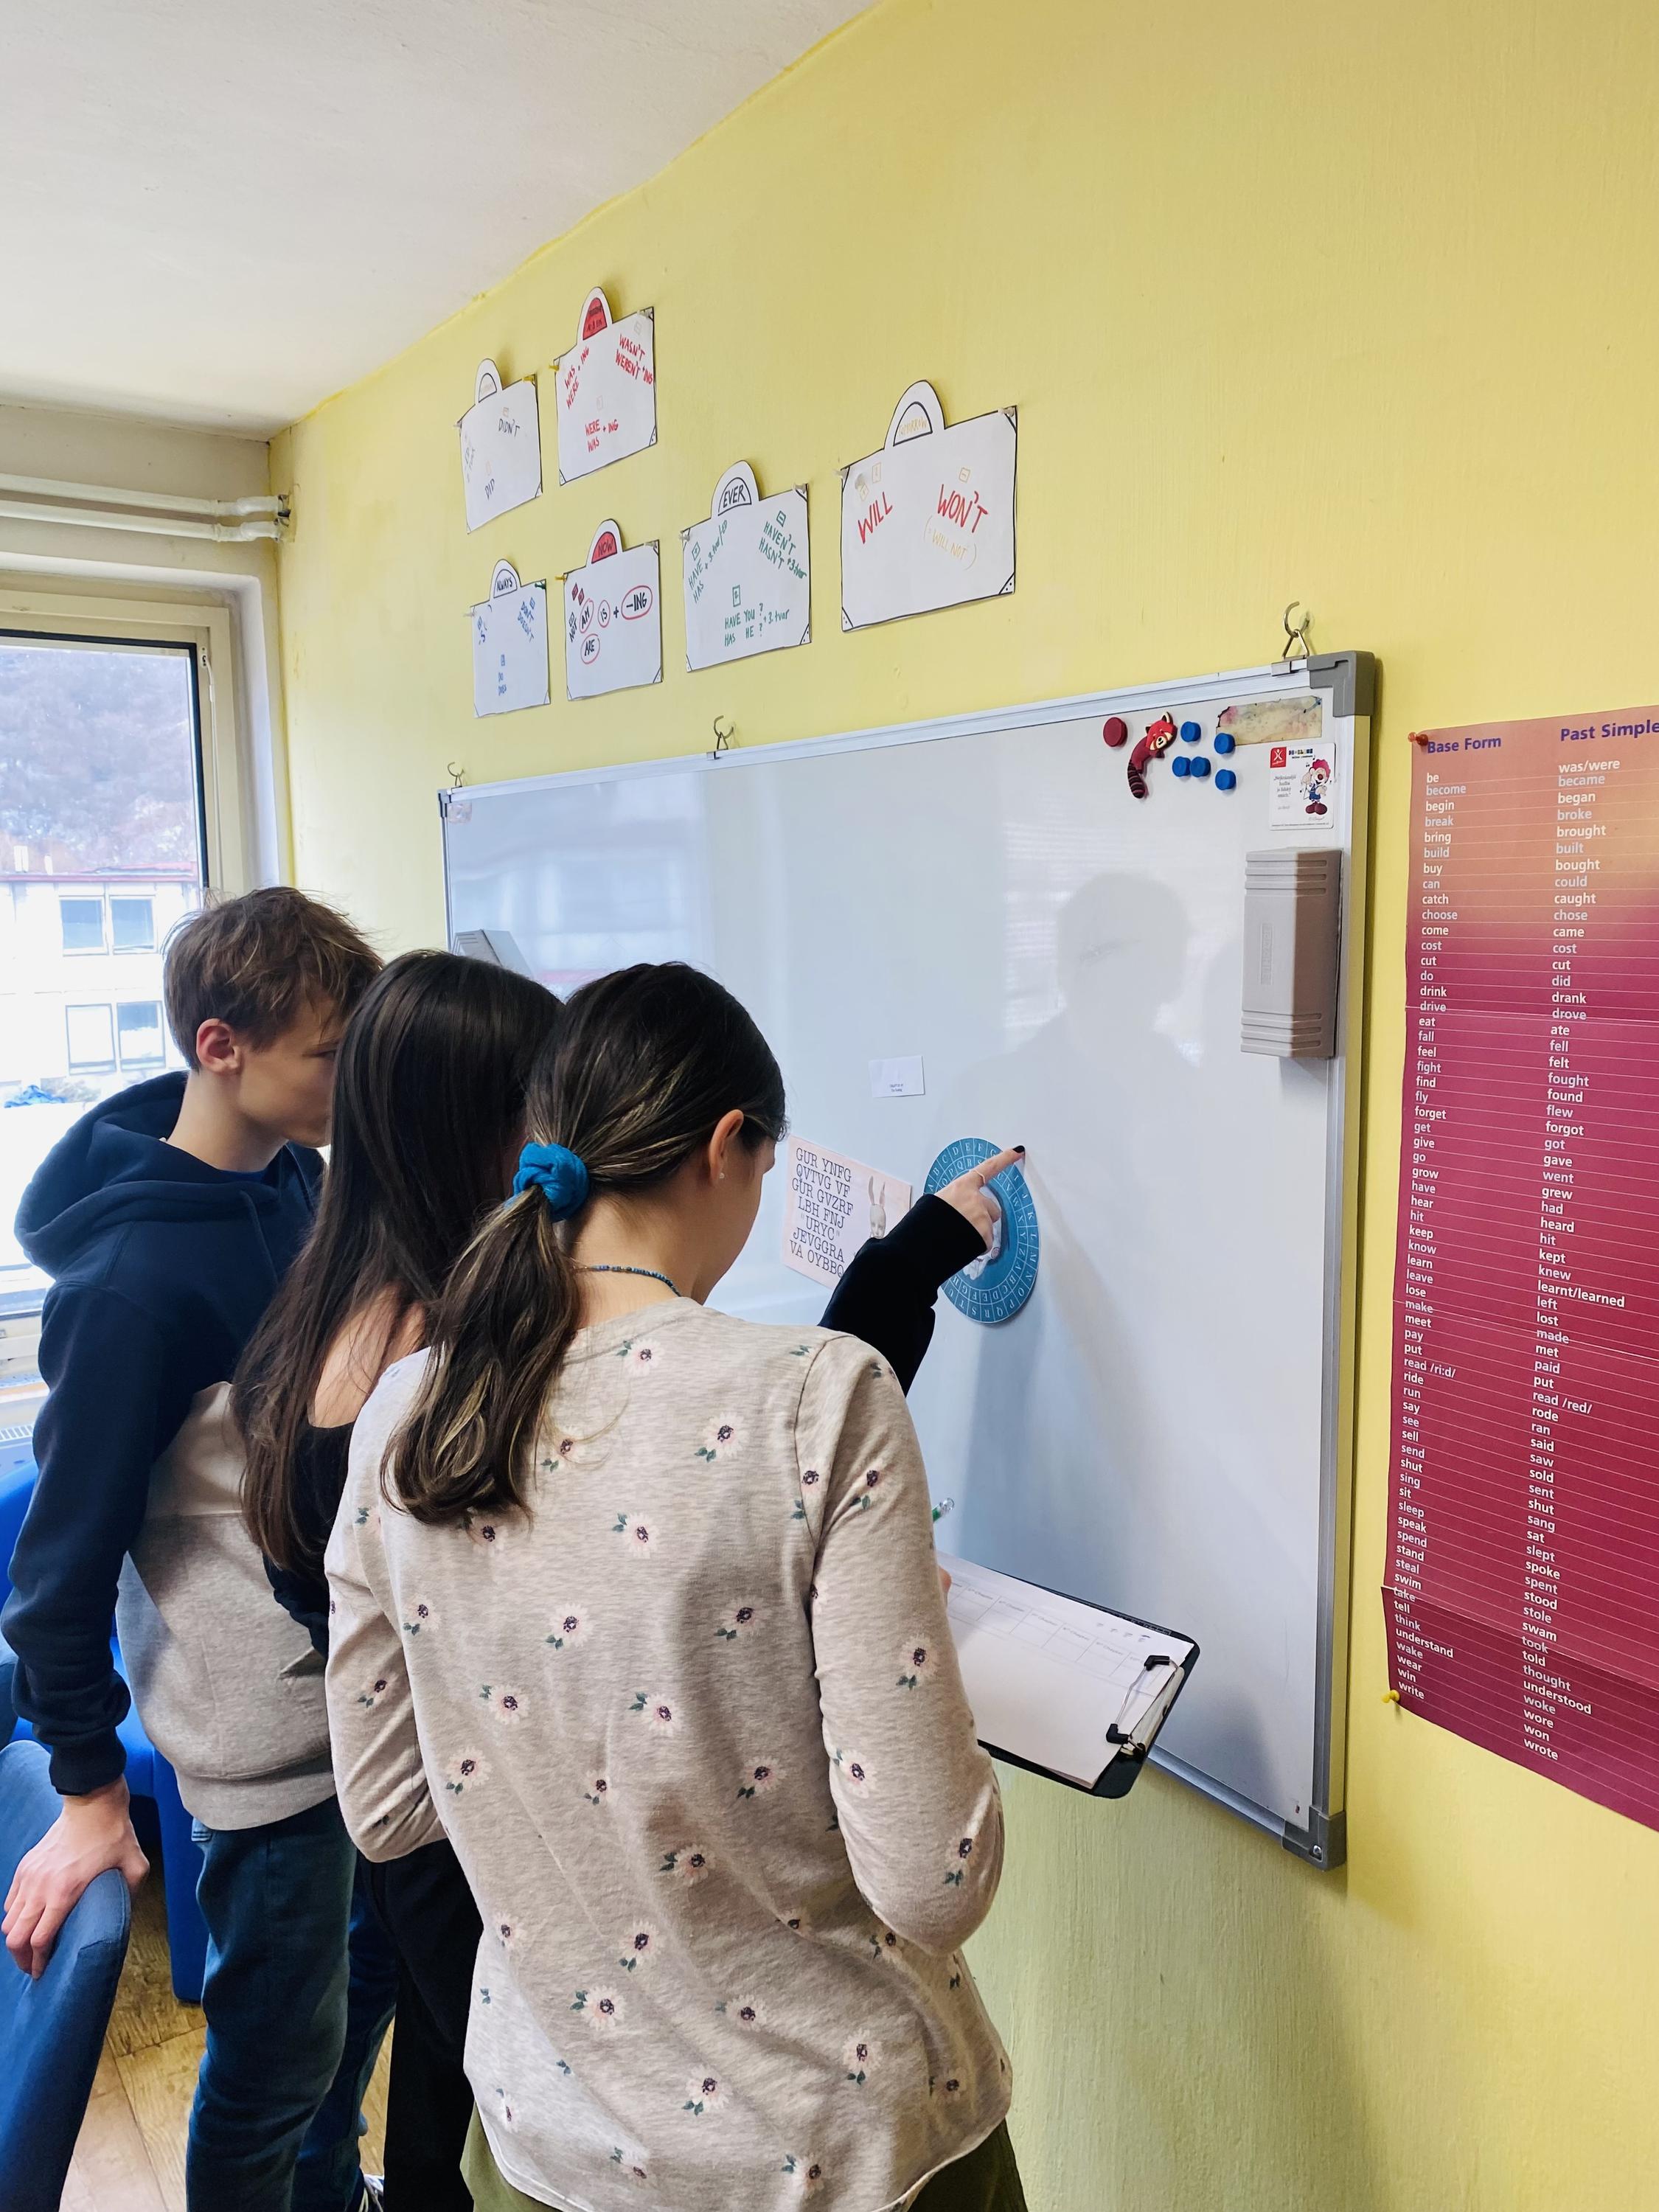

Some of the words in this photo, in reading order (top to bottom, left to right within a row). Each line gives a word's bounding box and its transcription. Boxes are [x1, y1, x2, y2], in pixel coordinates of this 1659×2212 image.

[619, 333, 645, 361] WASN'T
[616, 349, 640, 380] WEREN'T
[498, 418, 520, 437] DIDN'T
[585, 419, 600, 437] WERE
[608, 419, 619, 434] ING
[588, 438, 599, 453] WAS
[484, 478, 495, 500] DID
[723, 484, 745, 508] EVER
[937, 484, 988, 533] WON'T
[858, 491, 893, 544] WILL
[763, 521, 796, 555] HAVEN'T
[598, 540, 613, 556] NOW
[759, 537, 785, 569] HASN'T
[689, 557, 703, 589] HAVE
[497, 577, 513, 591] ALWAYS
[693, 580, 704, 603] HAS
[569, 618, 577, 643] NOT
[582, 606, 590, 629] AM
[601, 608, 608, 622] IS
[725, 613, 741, 630] HAVE
[744, 609, 755, 622] YOU
[725, 633, 736, 647] HAS
[745, 625, 754, 639] HE
[584, 639, 595, 656] ARE
[1561, 728, 1596, 741] Past
[1601, 720, 1659, 738] Simple
[1427, 742, 1459, 754] Base
[1464, 737, 1502, 751] Form
[1559, 759, 1620, 773] was/were
[1427, 773, 1439, 783] be
[1426, 799, 1455, 812] begin
[1558, 792, 1596, 805] began
[1425, 832, 1451, 844] bring
[1557, 825, 1606, 839] brought
[1424, 863, 1442, 876] buy
[1555, 860, 1600, 872] bought
[1422, 894, 1448, 905] catch
[1554, 894, 1596, 906] caught
[1422, 926, 1449, 936] come
[1554, 927, 1585, 937] came
[1422, 941, 1441, 951] cost
[1553, 944, 1576, 953] cost
[1421, 956, 1436, 967] cut
[1552, 960, 1571, 970] cut
[1420, 971, 1433, 981] do
[1552, 975, 1571, 987] did
[1420, 986, 1447, 997] drink
[1552, 992, 1587, 1004] drank
[1419, 1018, 1436, 1027] eat
[1419, 1032, 1434, 1042] fall
[1551, 1026, 1570, 1035] ate
[1417, 1047, 1436, 1057] feel
[1550, 1041, 1568, 1052] fell
[1549, 1057, 1569, 1068] felt
[1416, 1077, 1436, 1088] find
[1548, 1090, 1583, 1102] found
[1415, 1107, 1446, 1120] forget
[1545, 1122, 1584, 1135] forgot
[1413, 1137, 1434, 1150] give
[796, 1147, 818, 1168] GUR
[822, 1158, 852, 1183] YNFG
[1543, 1156, 1572, 1168] gave
[796, 1164, 831, 1190] QVTVG
[835, 1179, 850, 1198] VF
[1413, 1168, 1439, 1180] grow
[792, 1178, 813, 1199] GUR
[817, 1189, 854, 1216] GVZRF
[1542, 1188, 1573, 1200] grew
[1411, 1196, 1433, 1208] hear
[798, 1196, 820, 1218] LBH
[824, 1208, 845, 1229] FNJ
[801, 1213, 840, 1241] "URYC"
[1541, 1217, 1574, 1232] heard
[1409, 1225, 1433, 1239] keep
[793, 1227, 845, 1262] JEVGGRA
[1408, 1240, 1436, 1254] know
[789, 1239, 804, 1259] VA
[807, 1249, 844, 1279] OYBBQ
[1408, 1255, 1433, 1269] learn
[1540, 1249, 1565, 1264] kept
[1407, 1270, 1433, 1284] leave
[1539, 1265, 1571, 1280] knew
[1405, 1284, 1426, 1297] lose
[1538, 1281, 1625, 1307] learnt/learned
[1537, 1297, 1557, 1310] left
[1405, 1315, 1432, 1327] meet
[1537, 1312, 1558, 1326] lost
[1405, 1329, 1423, 1342] pay
[1405, 1343, 1422, 1355] put
[1536, 1346, 1559, 1357] met
[1404, 1357, 1426, 1370] read
[1430, 1363, 1456, 1378] /ri:d/
[1534, 1360, 1560, 1374] paid
[1404, 1371, 1424, 1384] ride
[1534, 1377, 1554, 1388] put
[1403, 1387, 1420, 1398] run
[1403, 1402, 1420, 1414] say
[1533, 1392, 1558, 1405] read
[1562, 1398, 1592, 1415] /red/
[1532, 1408, 1558, 1422] rode
[1402, 1429, 1419, 1441] sell
[1531, 1424, 1550, 1435] ran
[1402, 1444, 1425, 1458] send
[1531, 1439, 1554, 1452] said
[1401, 1458, 1422, 1472] shut
[1399, 1473, 1420, 1488] sing
[1530, 1469, 1554, 1483] sold
[1399, 1487, 1411, 1498] sit
[1529, 1485, 1554, 1498] sent
[1399, 1502, 1425, 1517] sleep
[1528, 1499, 1554, 1514] shut
[1398, 1517, 1427, 1533] speak
[1528, 1516, 1555, 1532] sang
[1397, 1530, 1427, 1548] spend
[1527, 1531, 1545, 1543] sat
[1397, 1545, 1424, 1561] stand
[1526, 1545, 1555, 1562] slept
[1396, 1559, 1419, 1574] steal
[1526, 1560, 1560, 1579] spoke
[1395, 1573, 1422, 1590] swim
[1525, 1576, 1557, 1594] spent
[1394, 1601, 1410, 1614] tell
[1525, 1591, 1557, 1610] stood
[1524, 1606, 1551, 1624] stole
[1523, 1621, 1557, 1641] swam
[1396, 1628, 1453, 1658] understand
[1397, 1655, 1422, 1672] wear
[1523, 1650, 1545, 1666] told
[1398, 1668, 1416, 1683] win
[1399, 1682, 1425, 1699] write
[1524, 1680, 1592, 1714] understood
[1524, 1709, 1554, 1728] wore
[1524, 1724, 1550, 1741] won
[1524, 1739, 1558, 1760] wrote
